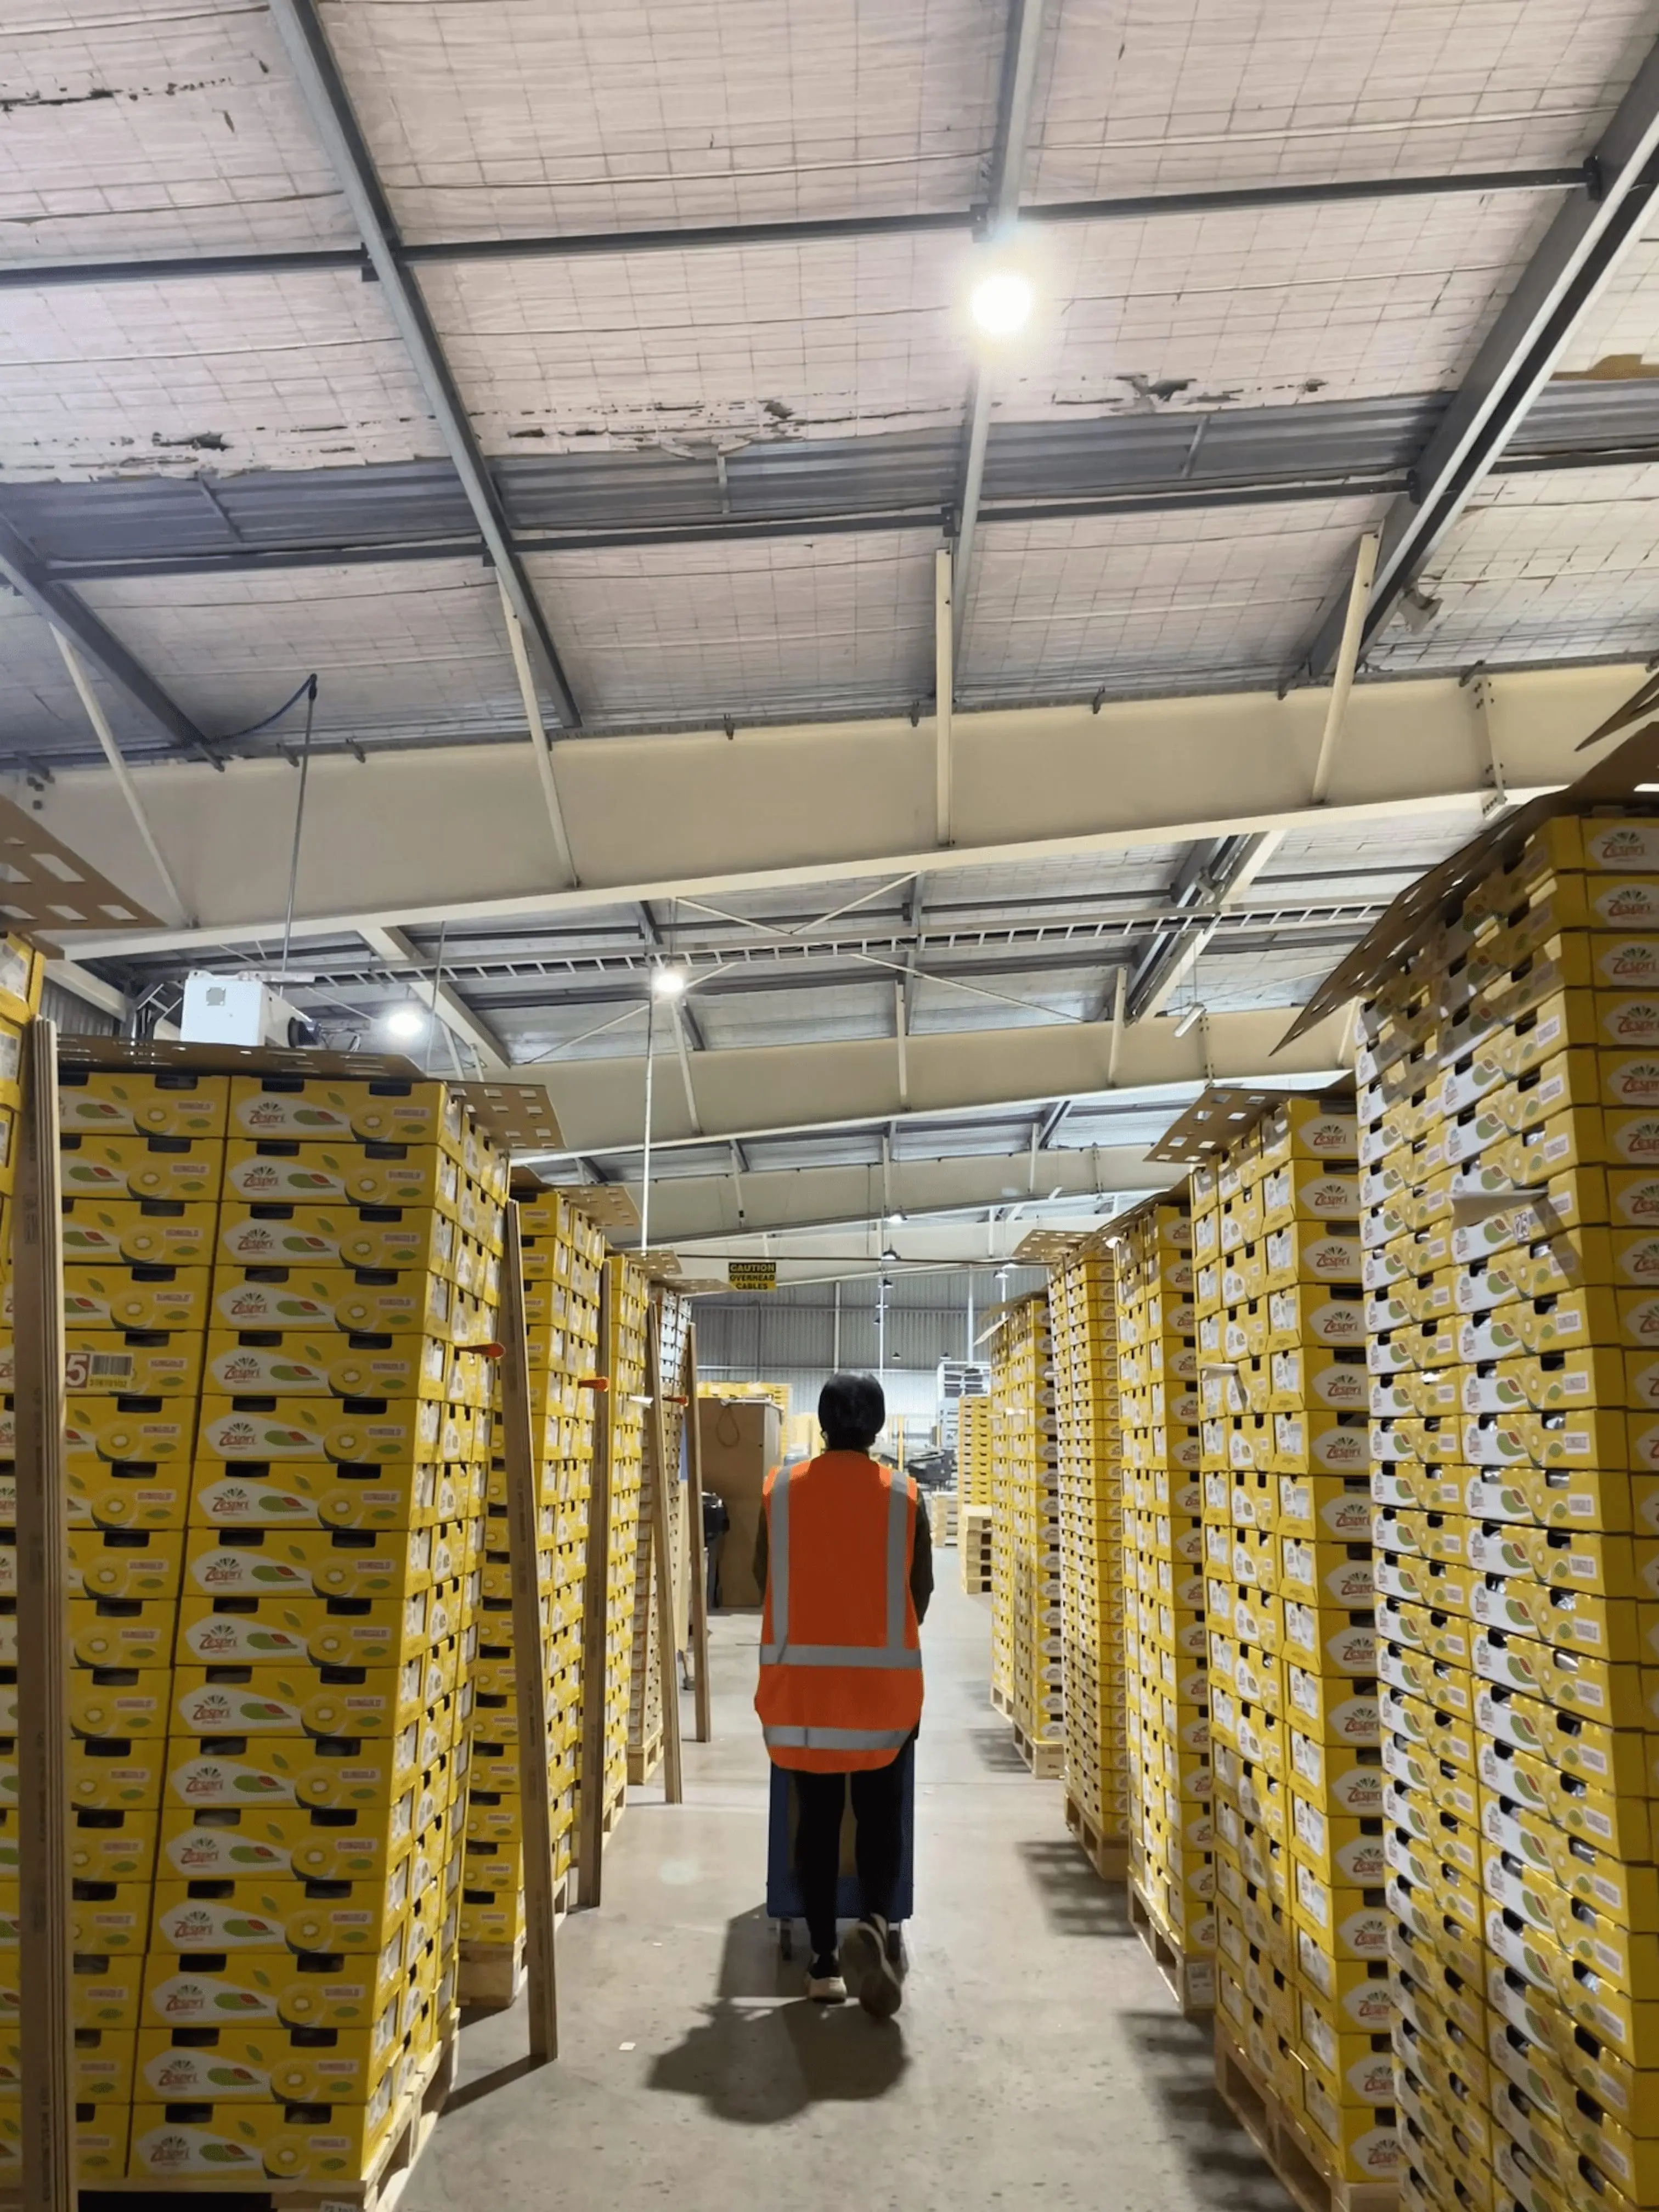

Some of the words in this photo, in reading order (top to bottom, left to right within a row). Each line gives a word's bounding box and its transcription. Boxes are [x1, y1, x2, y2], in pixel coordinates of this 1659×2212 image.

[1601, 841, 1645, 858] Zespri
[1609, 900, 1650, 916] Zespri
[1613, 957, 1657, 974] Zespri
[1621, 1076, 1659, 1093] Zespr
[249, 1110, 286, 1125] Zespri
[1313, 1132, 1346, 1146] Zespri
[244, 1173, 278, 1188] Zespri
[1314, 1192, 1347, 1207] Zespri
[238, 1236, 273, 1251] Zespri
[730, 1263, 775, 1272] CAUTION
[1316, 1254, 1349, 1268] Zespri
[232, 1300, 267, 1315] Zespri
[1323, 1319, 1357, 1334] Zespri
[224, 1365, 260, 1380] Zespri
[1327, 1383, 1361, 1397] Zespri
[219, 1431, 256, 1446] Zespri
[1327, 1444, 1361, 1460] Zespri
[212, 1497, 249, 1513] Zespri
[205, 1566, 242, 1582] Zespri
[199, 1634, 236, 1650] Zespri
[193, 1705, 231, 1721] Zespri
[185, 1777, 223, 1793] Zespri
[180, 1848, 218, 1864] Zespri
[174, 1922, 212, 1938] Zespri
[166, 1995, 204, 2012] Zespri
[159, 2069, 198, 2086] Zespri
